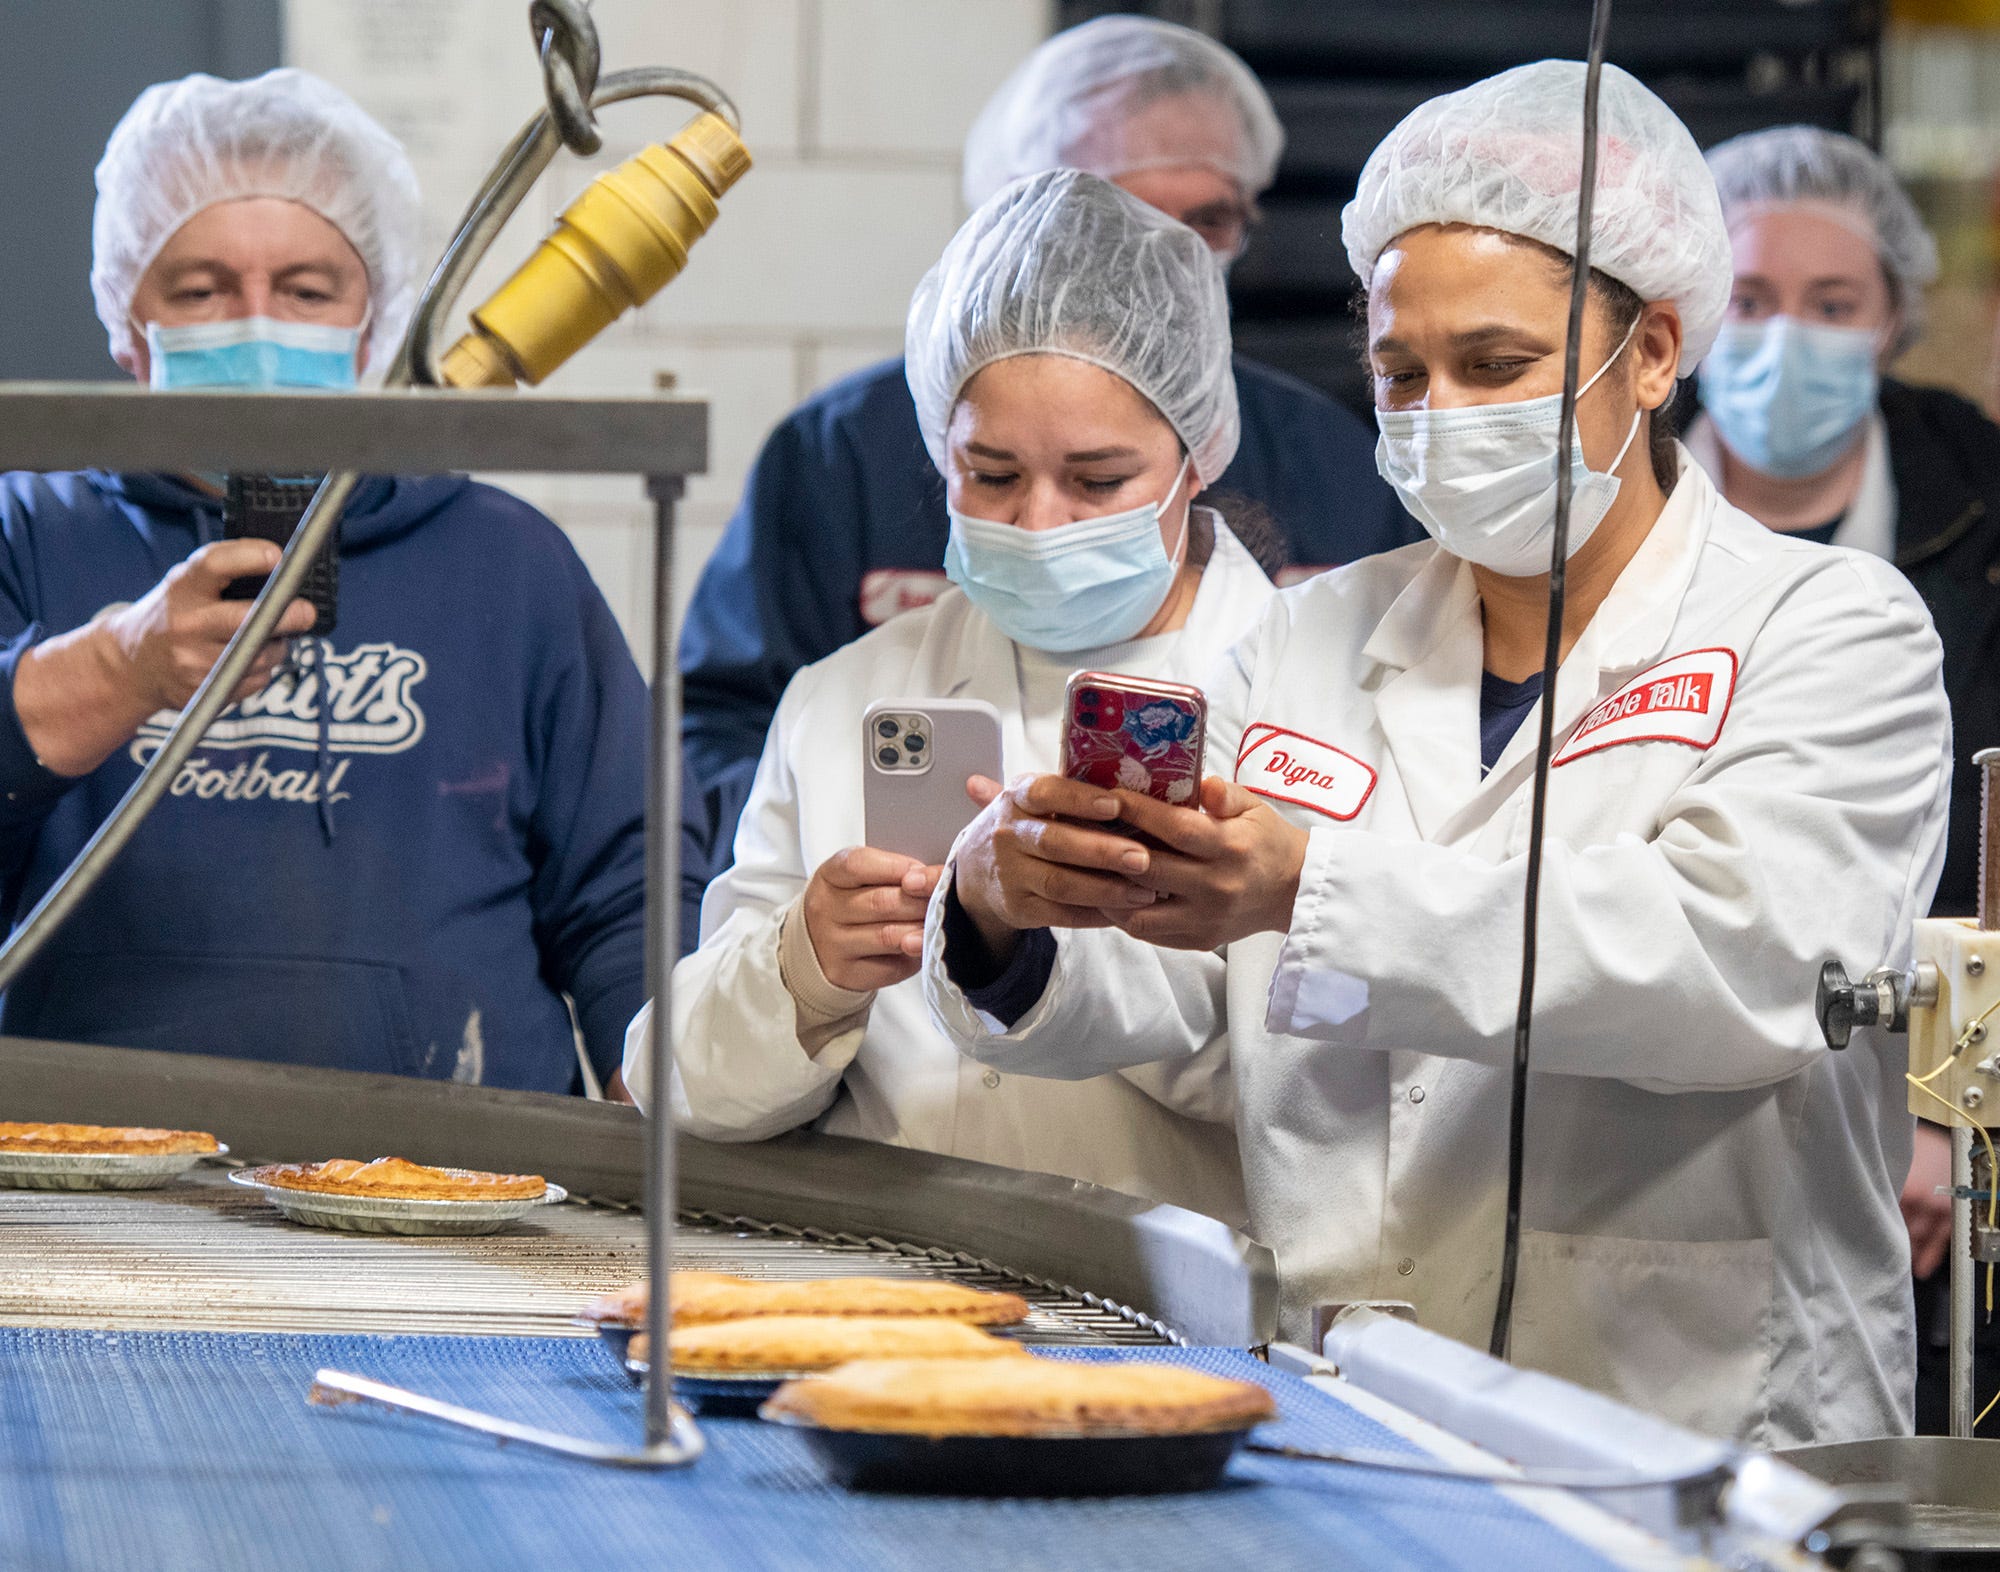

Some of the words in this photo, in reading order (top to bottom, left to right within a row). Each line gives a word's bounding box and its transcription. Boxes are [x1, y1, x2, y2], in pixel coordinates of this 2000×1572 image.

[1581, 692, 1642, 734] Table
[1647, 675, 1701, 711] Talk
[152, 752, 350, 804] ootball
[1264, 750, 1335, 791] Digna
